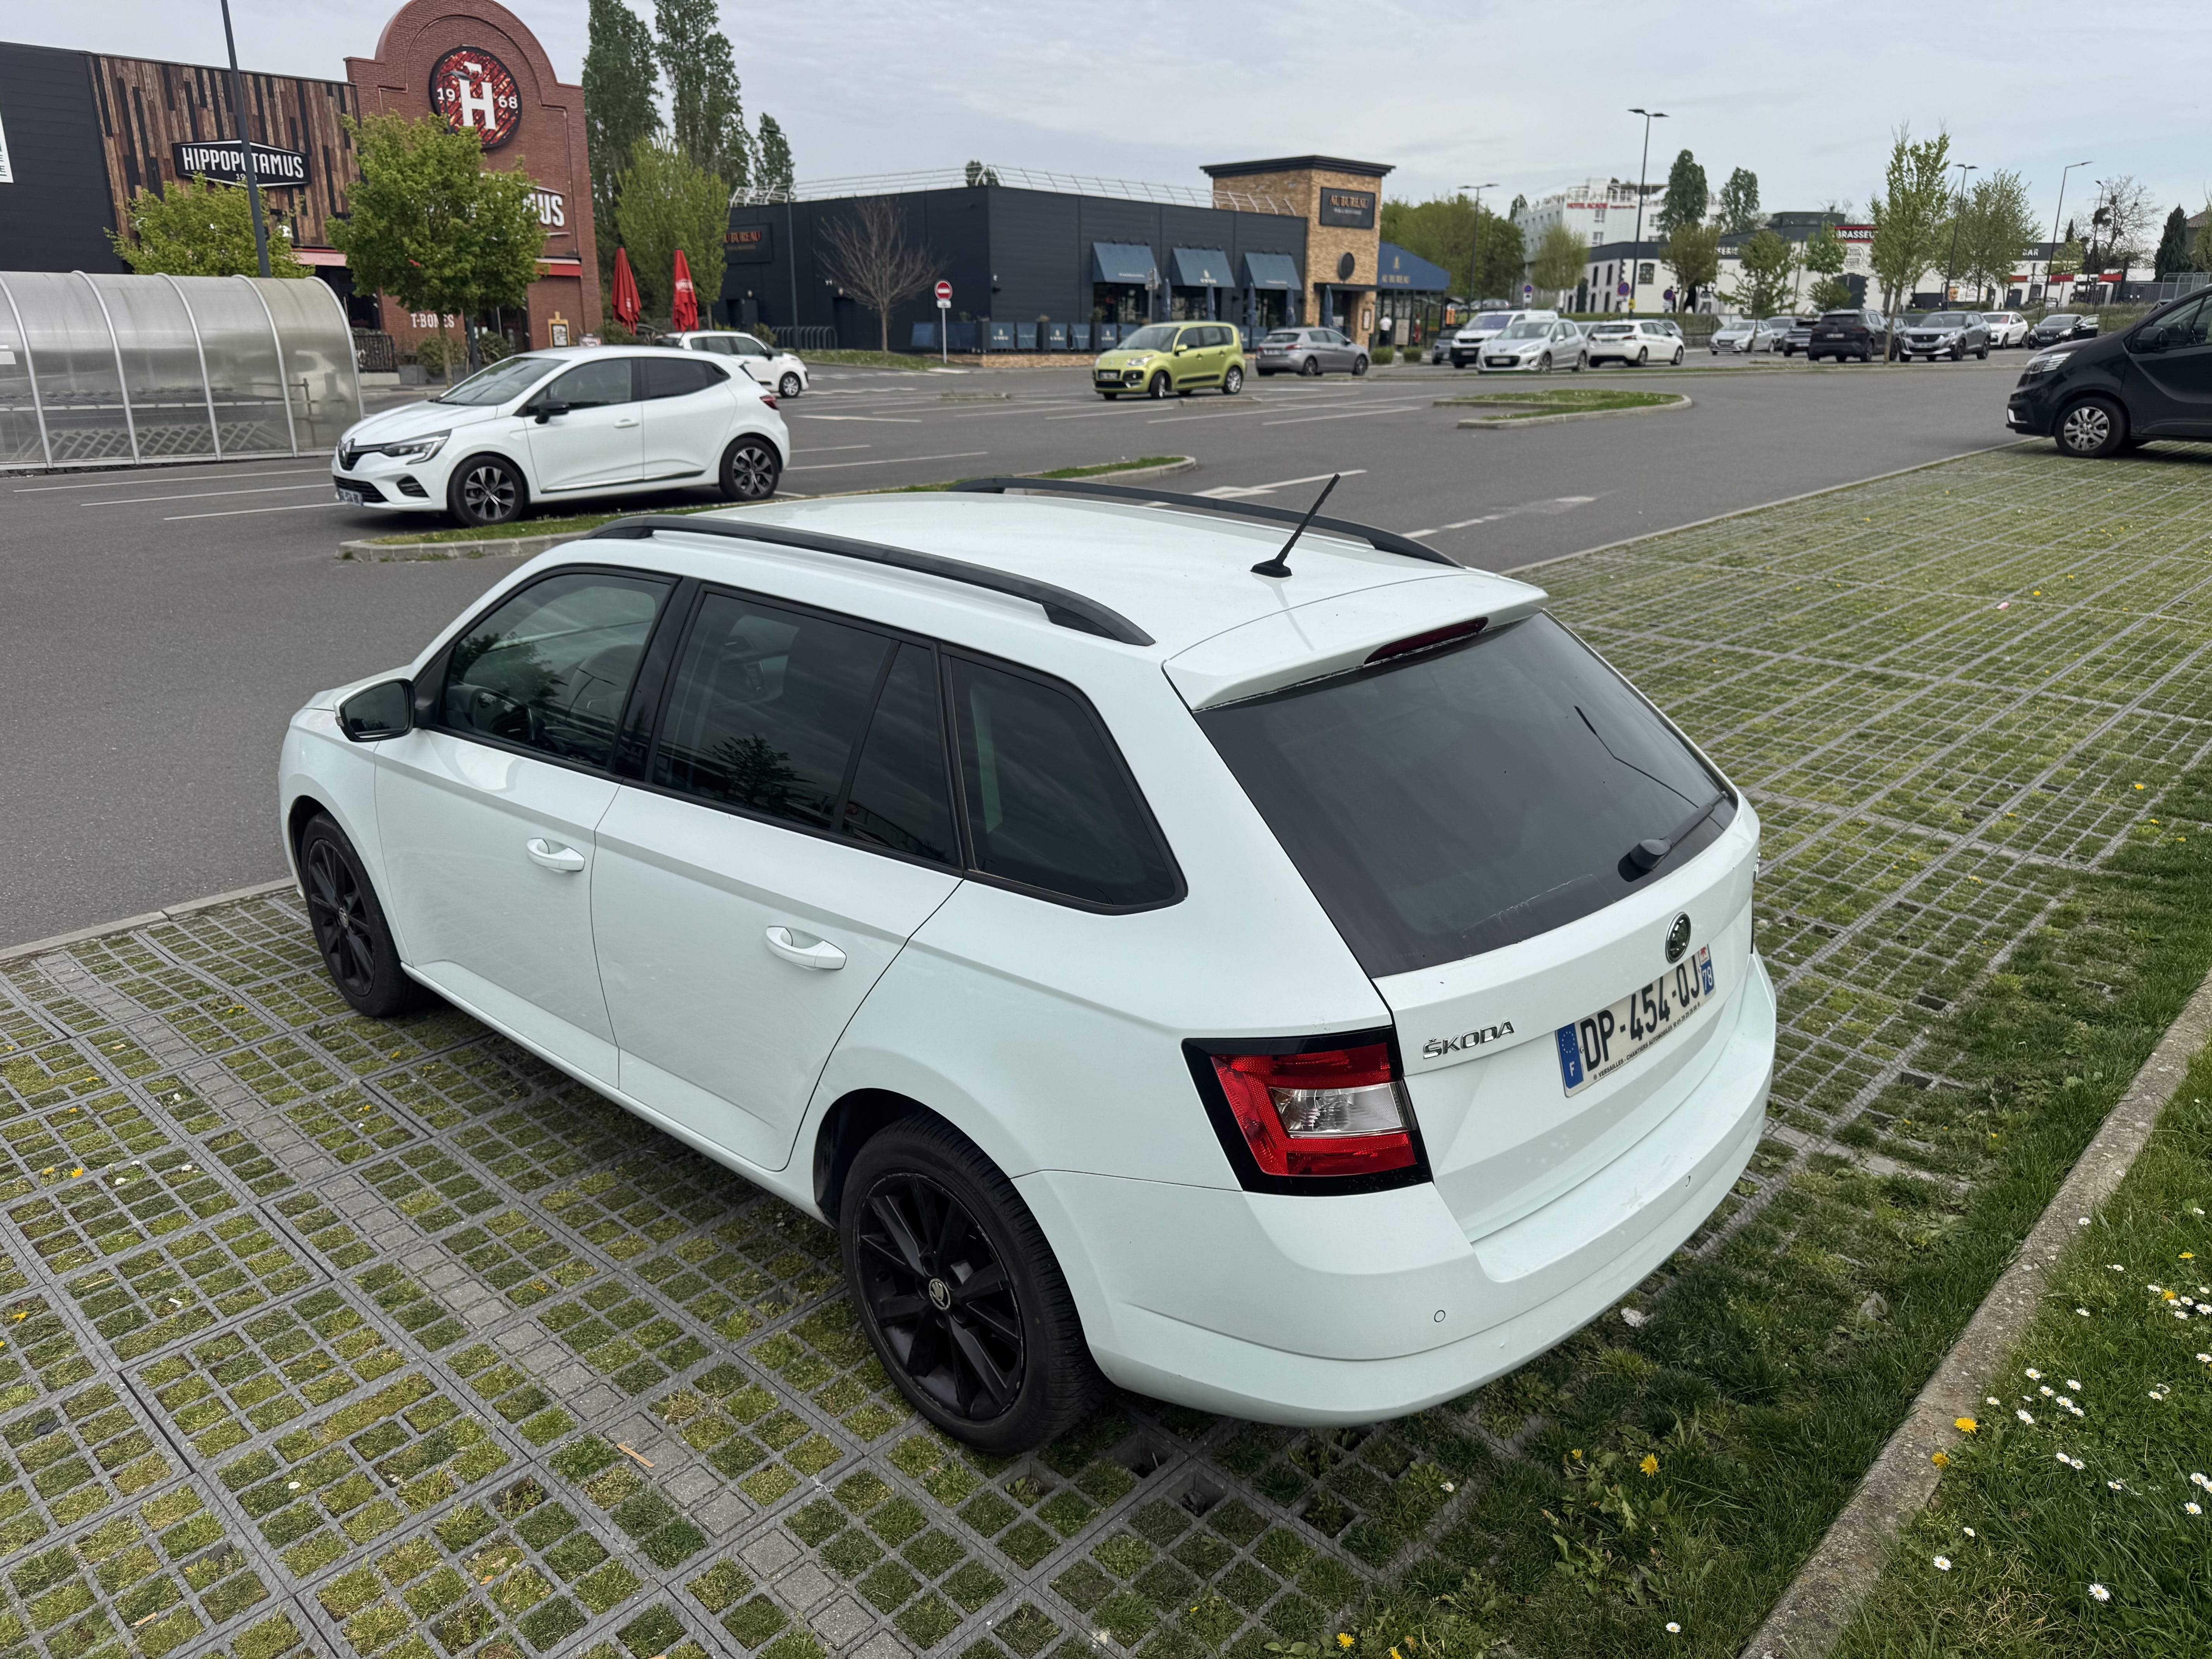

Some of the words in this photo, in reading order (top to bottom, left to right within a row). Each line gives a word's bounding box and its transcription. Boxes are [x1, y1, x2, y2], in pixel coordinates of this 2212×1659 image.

[437, 88, 455, 101] 19
[459, 79, 497, 130] H
[498, 95, 518, 109] 68
[1702, 966, 1712, 991] 78
[1423, 1020, 1515, 1060] ŠKODA
[1598, 1058, 1624, 1078] VERSAILLES
[1626, 1042, 1648, 1061] CHANTIERS
[1649, 1025, 1673, 1046] AUTOMOBILES
[1569, 1061, 1575, 1077] F
